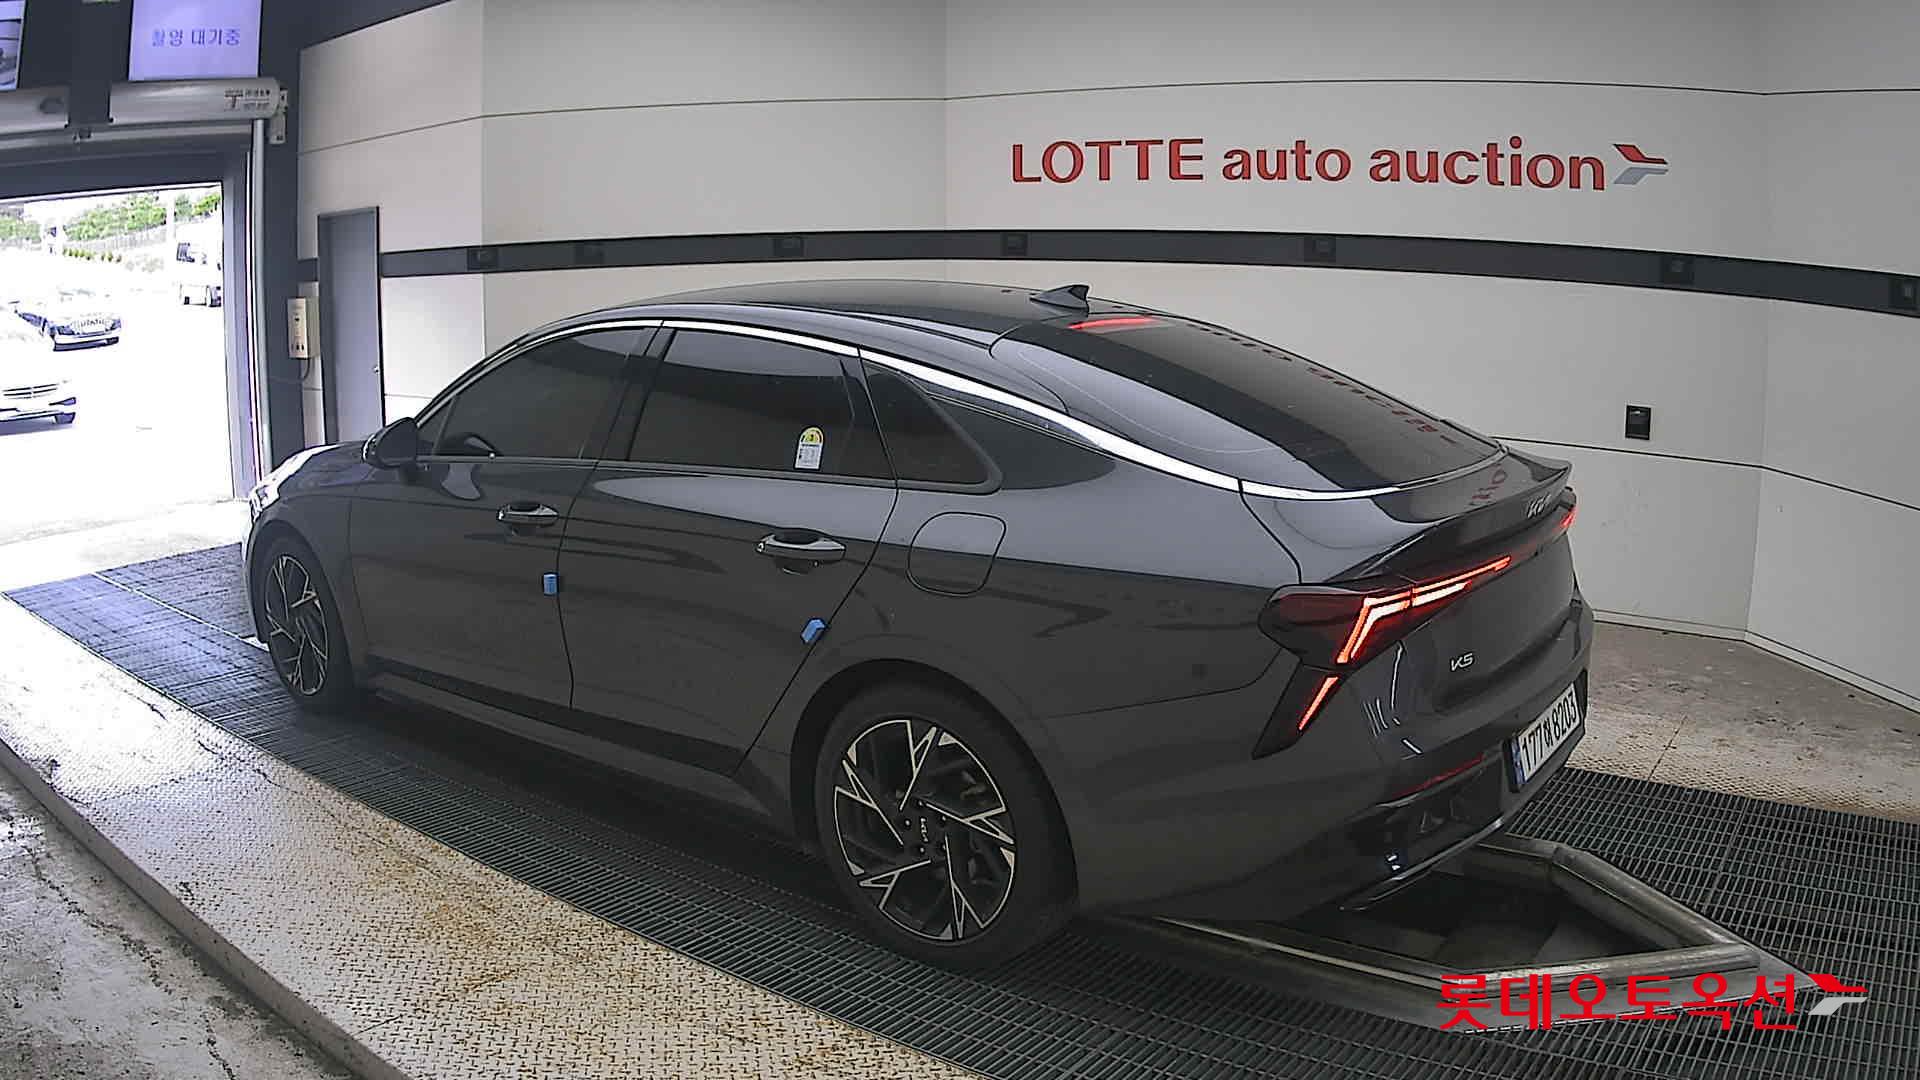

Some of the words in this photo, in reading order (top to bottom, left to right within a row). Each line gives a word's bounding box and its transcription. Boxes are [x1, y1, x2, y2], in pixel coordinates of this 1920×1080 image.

[191, 28, 240, 46] 대기중
[1012, 138, 1203, 183] LOTTE
[1222, 140, 1352, 182] auto
[1369, 136, 1606, 191] auction
